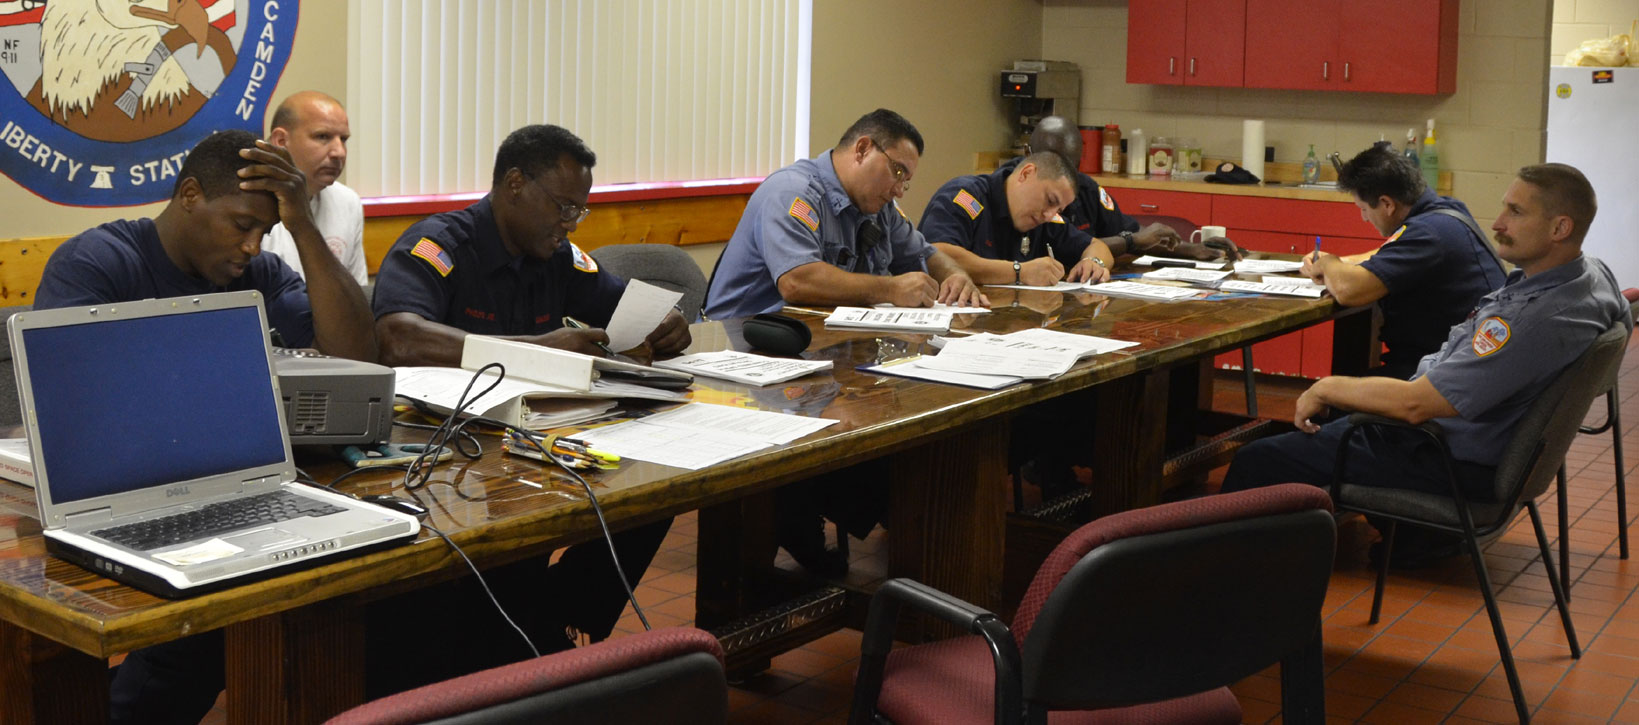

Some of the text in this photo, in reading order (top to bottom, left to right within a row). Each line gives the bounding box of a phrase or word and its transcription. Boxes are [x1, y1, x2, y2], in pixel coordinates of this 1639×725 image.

[235, 0, 279, 120] CAMDEN
[0, 121, 190, 185] IBERTY STAT
[166, 486, 191, 497] DELL
